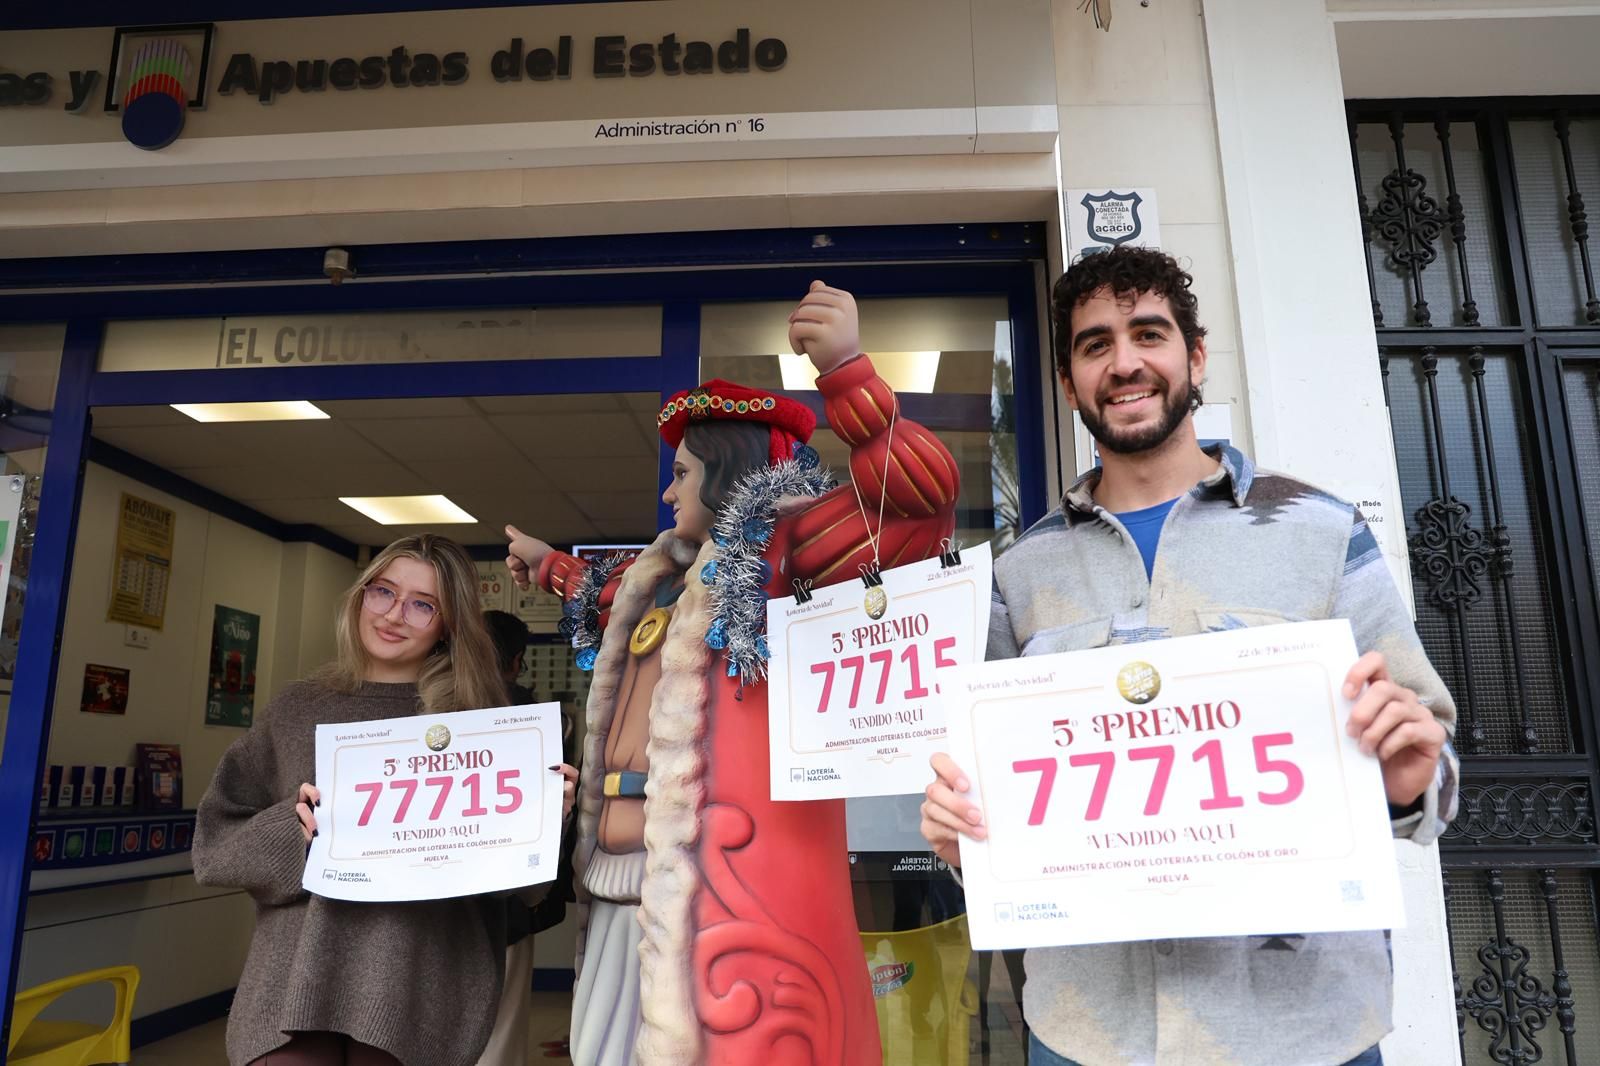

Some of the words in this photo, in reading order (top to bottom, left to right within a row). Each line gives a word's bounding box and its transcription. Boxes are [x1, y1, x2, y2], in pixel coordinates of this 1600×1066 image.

[0, 71, 53, 107] as
[65, 70, 98, 113] y
[218, 46, 470, 105] Apuestas
[490, 35, 573, 83] del
[593, 28, 788, 79] Estado
[595, 119, 721, 138] Administración
[748, 118, 765, 133] 16
[1095, 223, 1133, 233] acacio
[225, 326, 263, 365] EL
[481, 583, 500, 593] 80
[851, 613, 929, 649] PREMIO
[1238, 650, 1249, 658] 22
[1002, 679, 1012, 688] de
[850, 714, 892, 730] VENDIDO
[1092, 700, 1241, 741] PREMIO
[912, 728, 932, 738] COLÓN
[877, 747, 899, 755] HUELVA
[407, 749, 493, 774] PREMIO
[807, 774, 841, 782] NACIONAL
[1012, 732, 1304, 826] 77715
[355, 769, 523, 826] 77715
[393, 827, 446, 841] VENDIDO
[1087, 828, 1176, 849] VENDIDO
[466, 839, 488, 848] COLÓN
[1134, 858, 1147, 867] DE
[1202, 854, 1214, 863] EL
[1217, 850, 1255, 861] COLÓN
[1257, 850, 1270, 858] DE
[1274, 848, 1298, 857] ORO
[1148, 874, 1189, 883] HUELVA
[1018, 911, 1069, 920] NACIONAL
[871, 967, 903, 982] ipton
